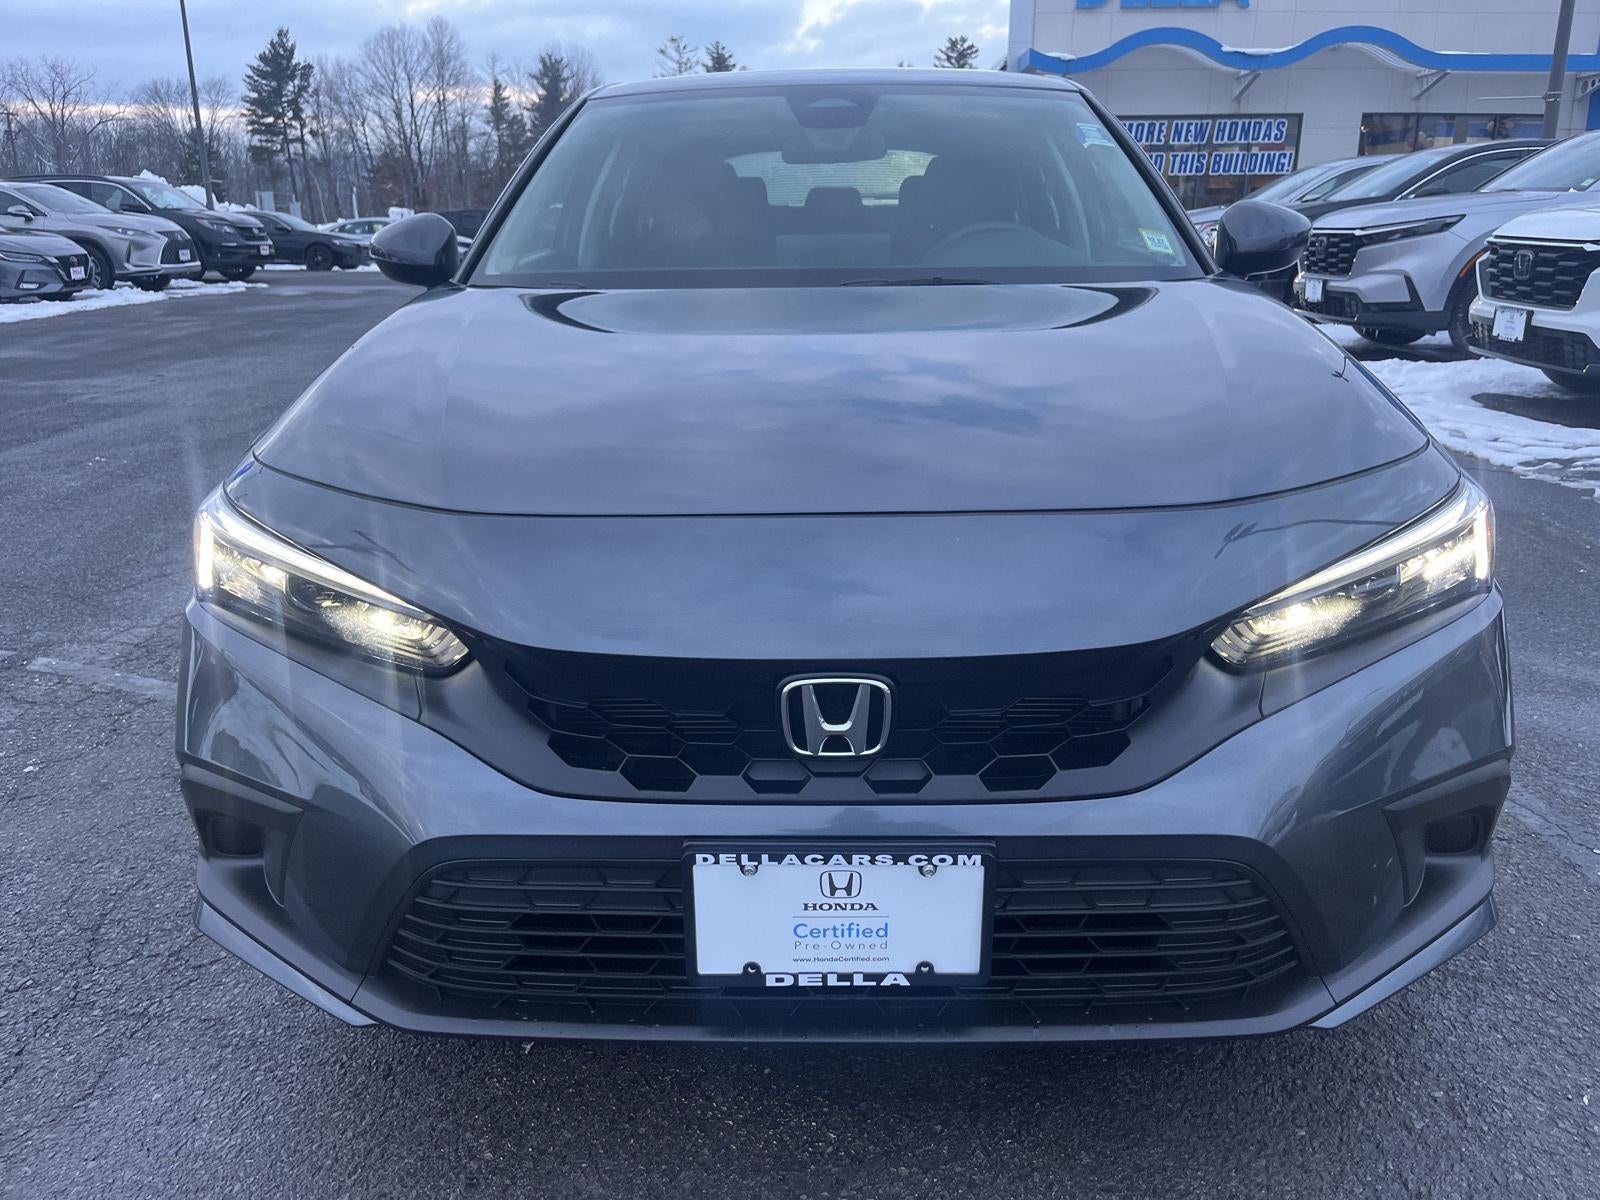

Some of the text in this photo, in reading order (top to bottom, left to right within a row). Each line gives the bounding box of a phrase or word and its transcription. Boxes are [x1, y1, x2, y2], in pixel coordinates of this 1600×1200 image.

[1170, 120, 1210, 144] NEW
[1213, 119, 1287, 143] HONDAS
[1168, 152, 1206, 175] THIS
[1209, 152, 1293, 175] BUILDING!
[695, 853, 982, 866] DELLACARS.COM
[802, 902, 879, 911] HONDA
[793, 922, 889, 939] Certified
[794, 940, 888, 950] Pre-Owned
[792, 955, 890, 963] www.HondaCertified.com
[765, 972, 911, 987] DELLA
